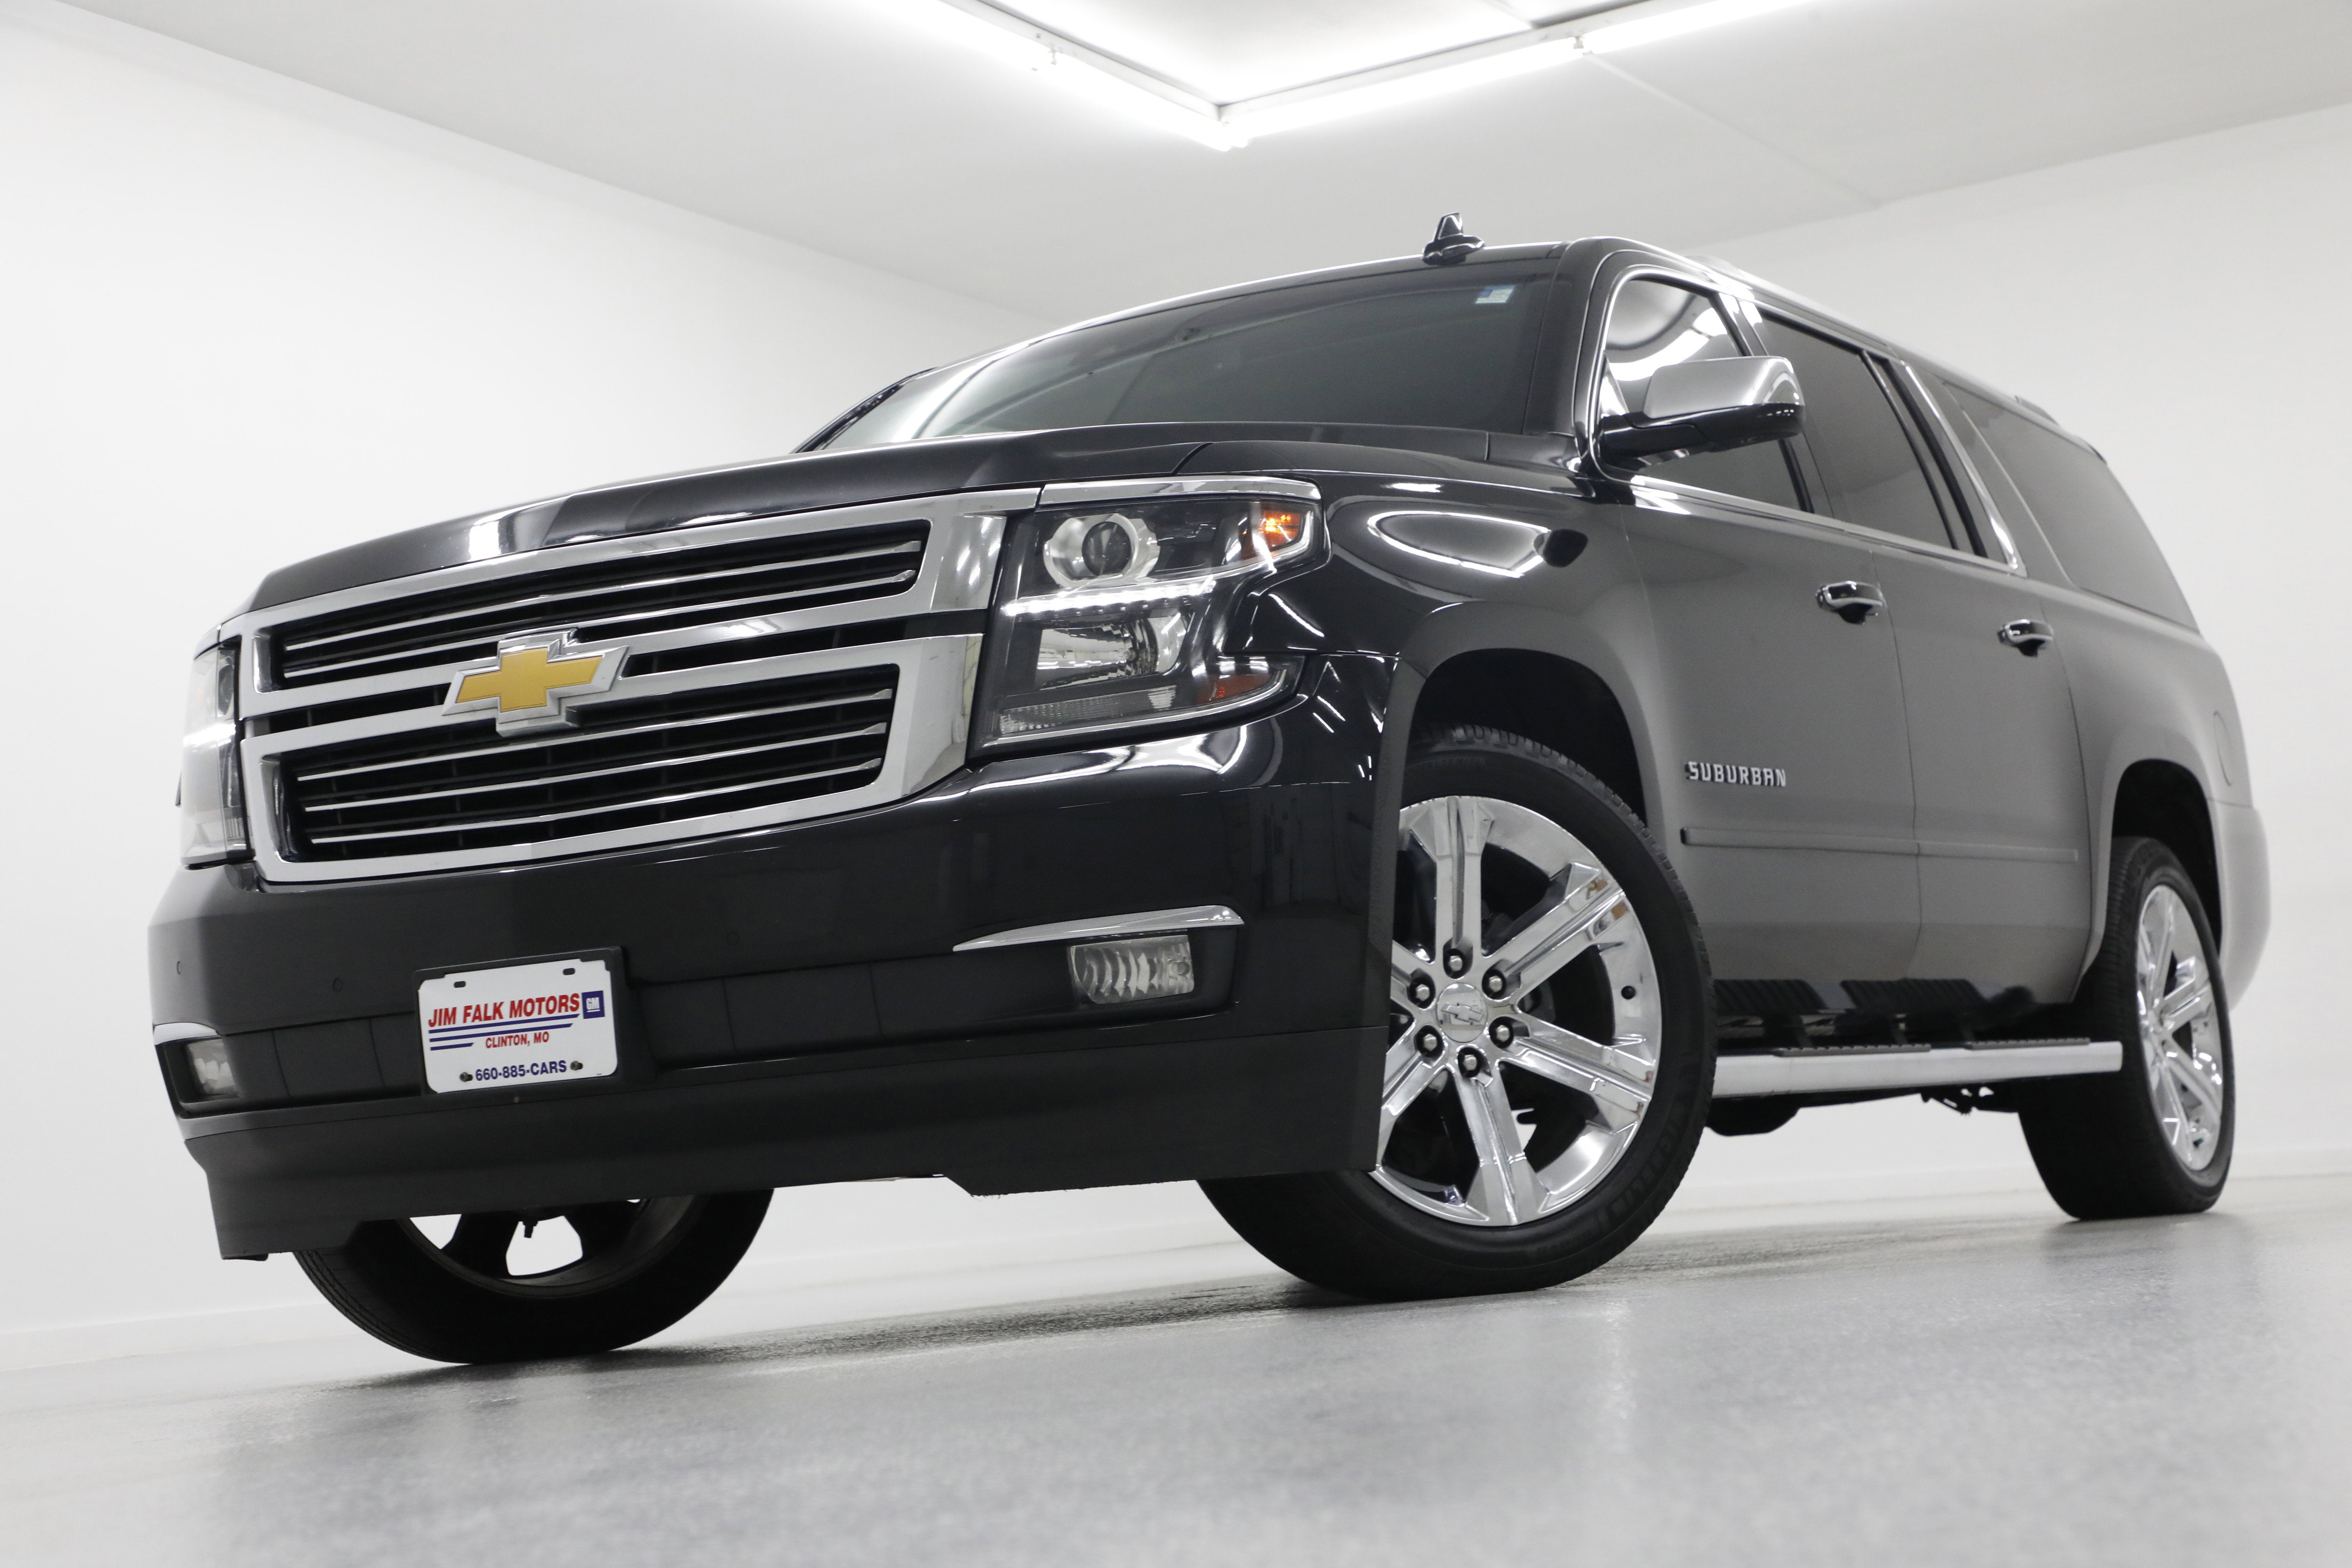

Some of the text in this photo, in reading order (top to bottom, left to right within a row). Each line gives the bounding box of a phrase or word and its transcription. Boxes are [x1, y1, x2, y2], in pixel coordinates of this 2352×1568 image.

[1686, 761, 1786, 787] SUBURBAN
[428, 993, 580, 1027] JIM FALK MOTORS
[586, 997, 600, 1010] GM
[486, 1031, 549, 1049] CLINTON, MO
[476, 1060, 567, 1081] 660-885-CARS
